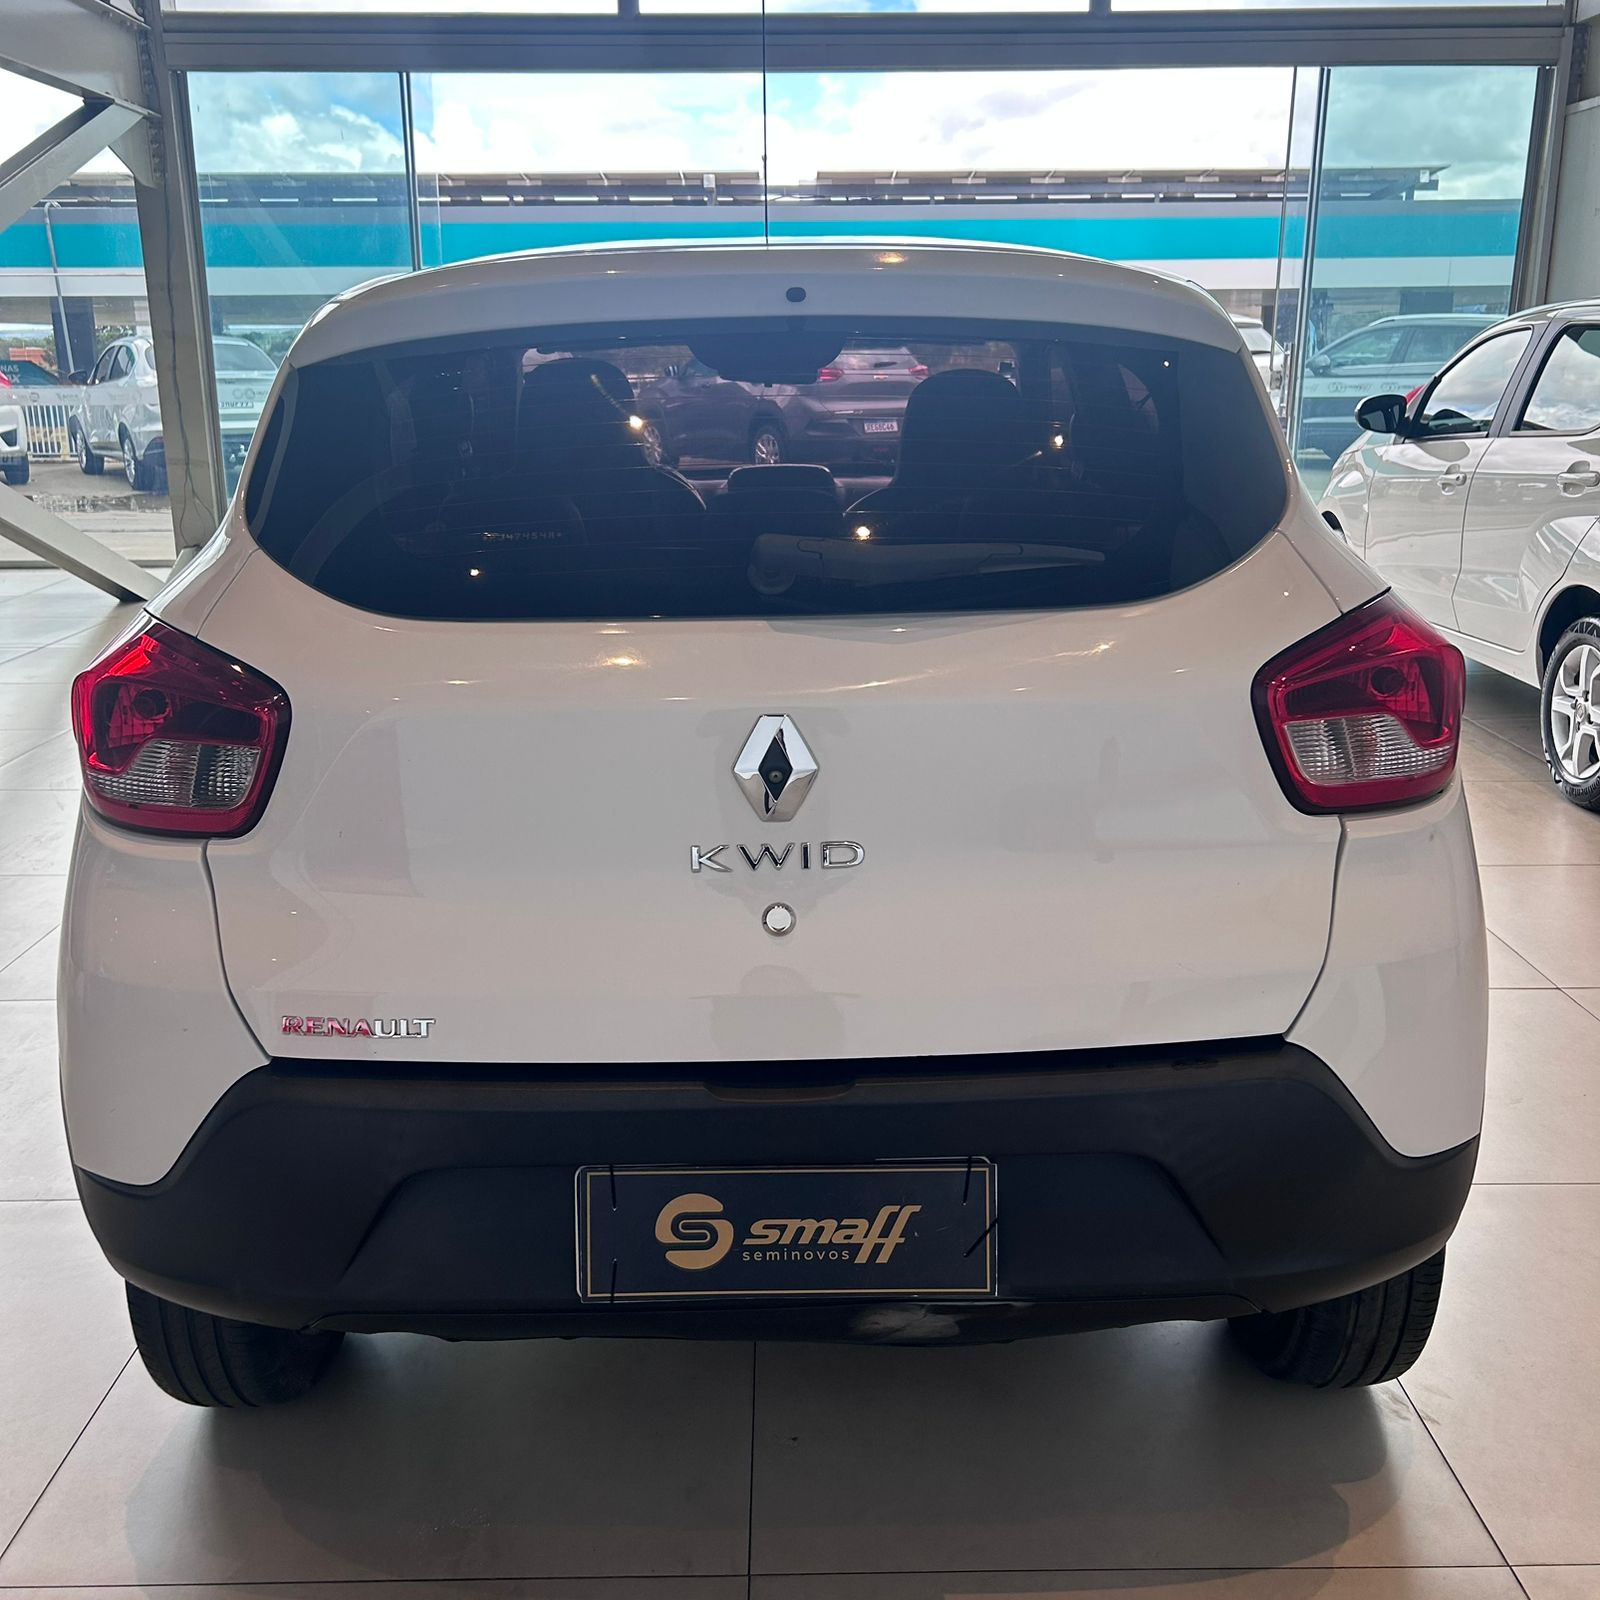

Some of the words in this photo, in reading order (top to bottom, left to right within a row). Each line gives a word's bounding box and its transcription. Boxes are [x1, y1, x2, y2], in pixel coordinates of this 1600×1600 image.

[691, 841, 865, 873] KWID
[281, 1015, 436, 1039] RENAULT
[743, 1205, 921, 1263] smaff
[743, 1248, 849, 1261] seminovos
